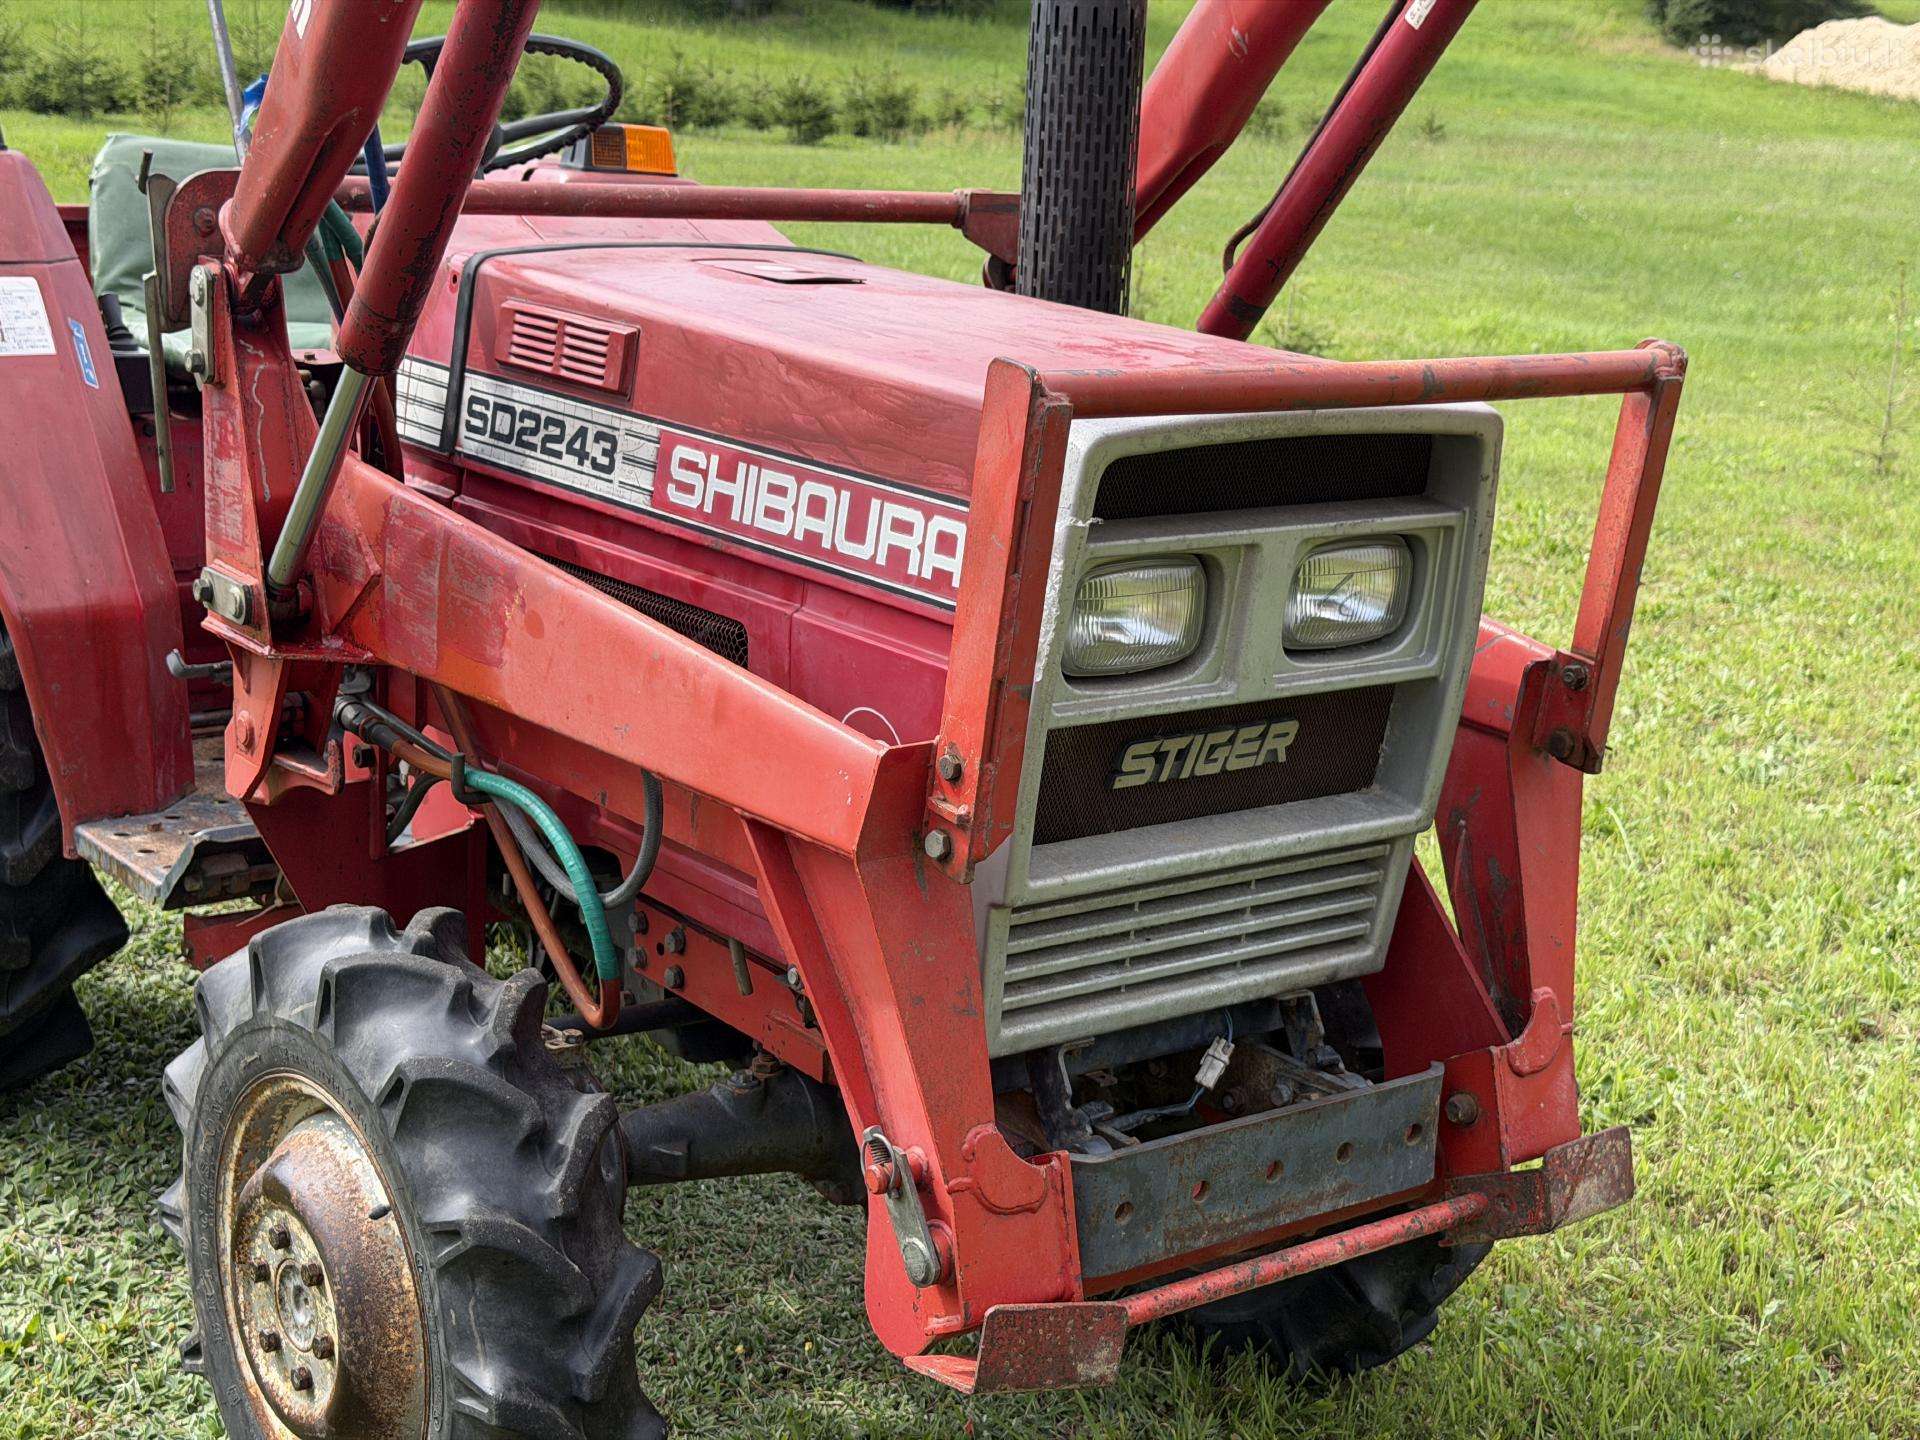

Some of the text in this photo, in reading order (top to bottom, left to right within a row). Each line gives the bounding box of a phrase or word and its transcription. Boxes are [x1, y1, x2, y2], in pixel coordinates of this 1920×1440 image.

[465, 394, 619, 475] SD2243
[667, 444, 967, 588] SHIBAURA
[1112, 719, 1300, 790] STIGER
